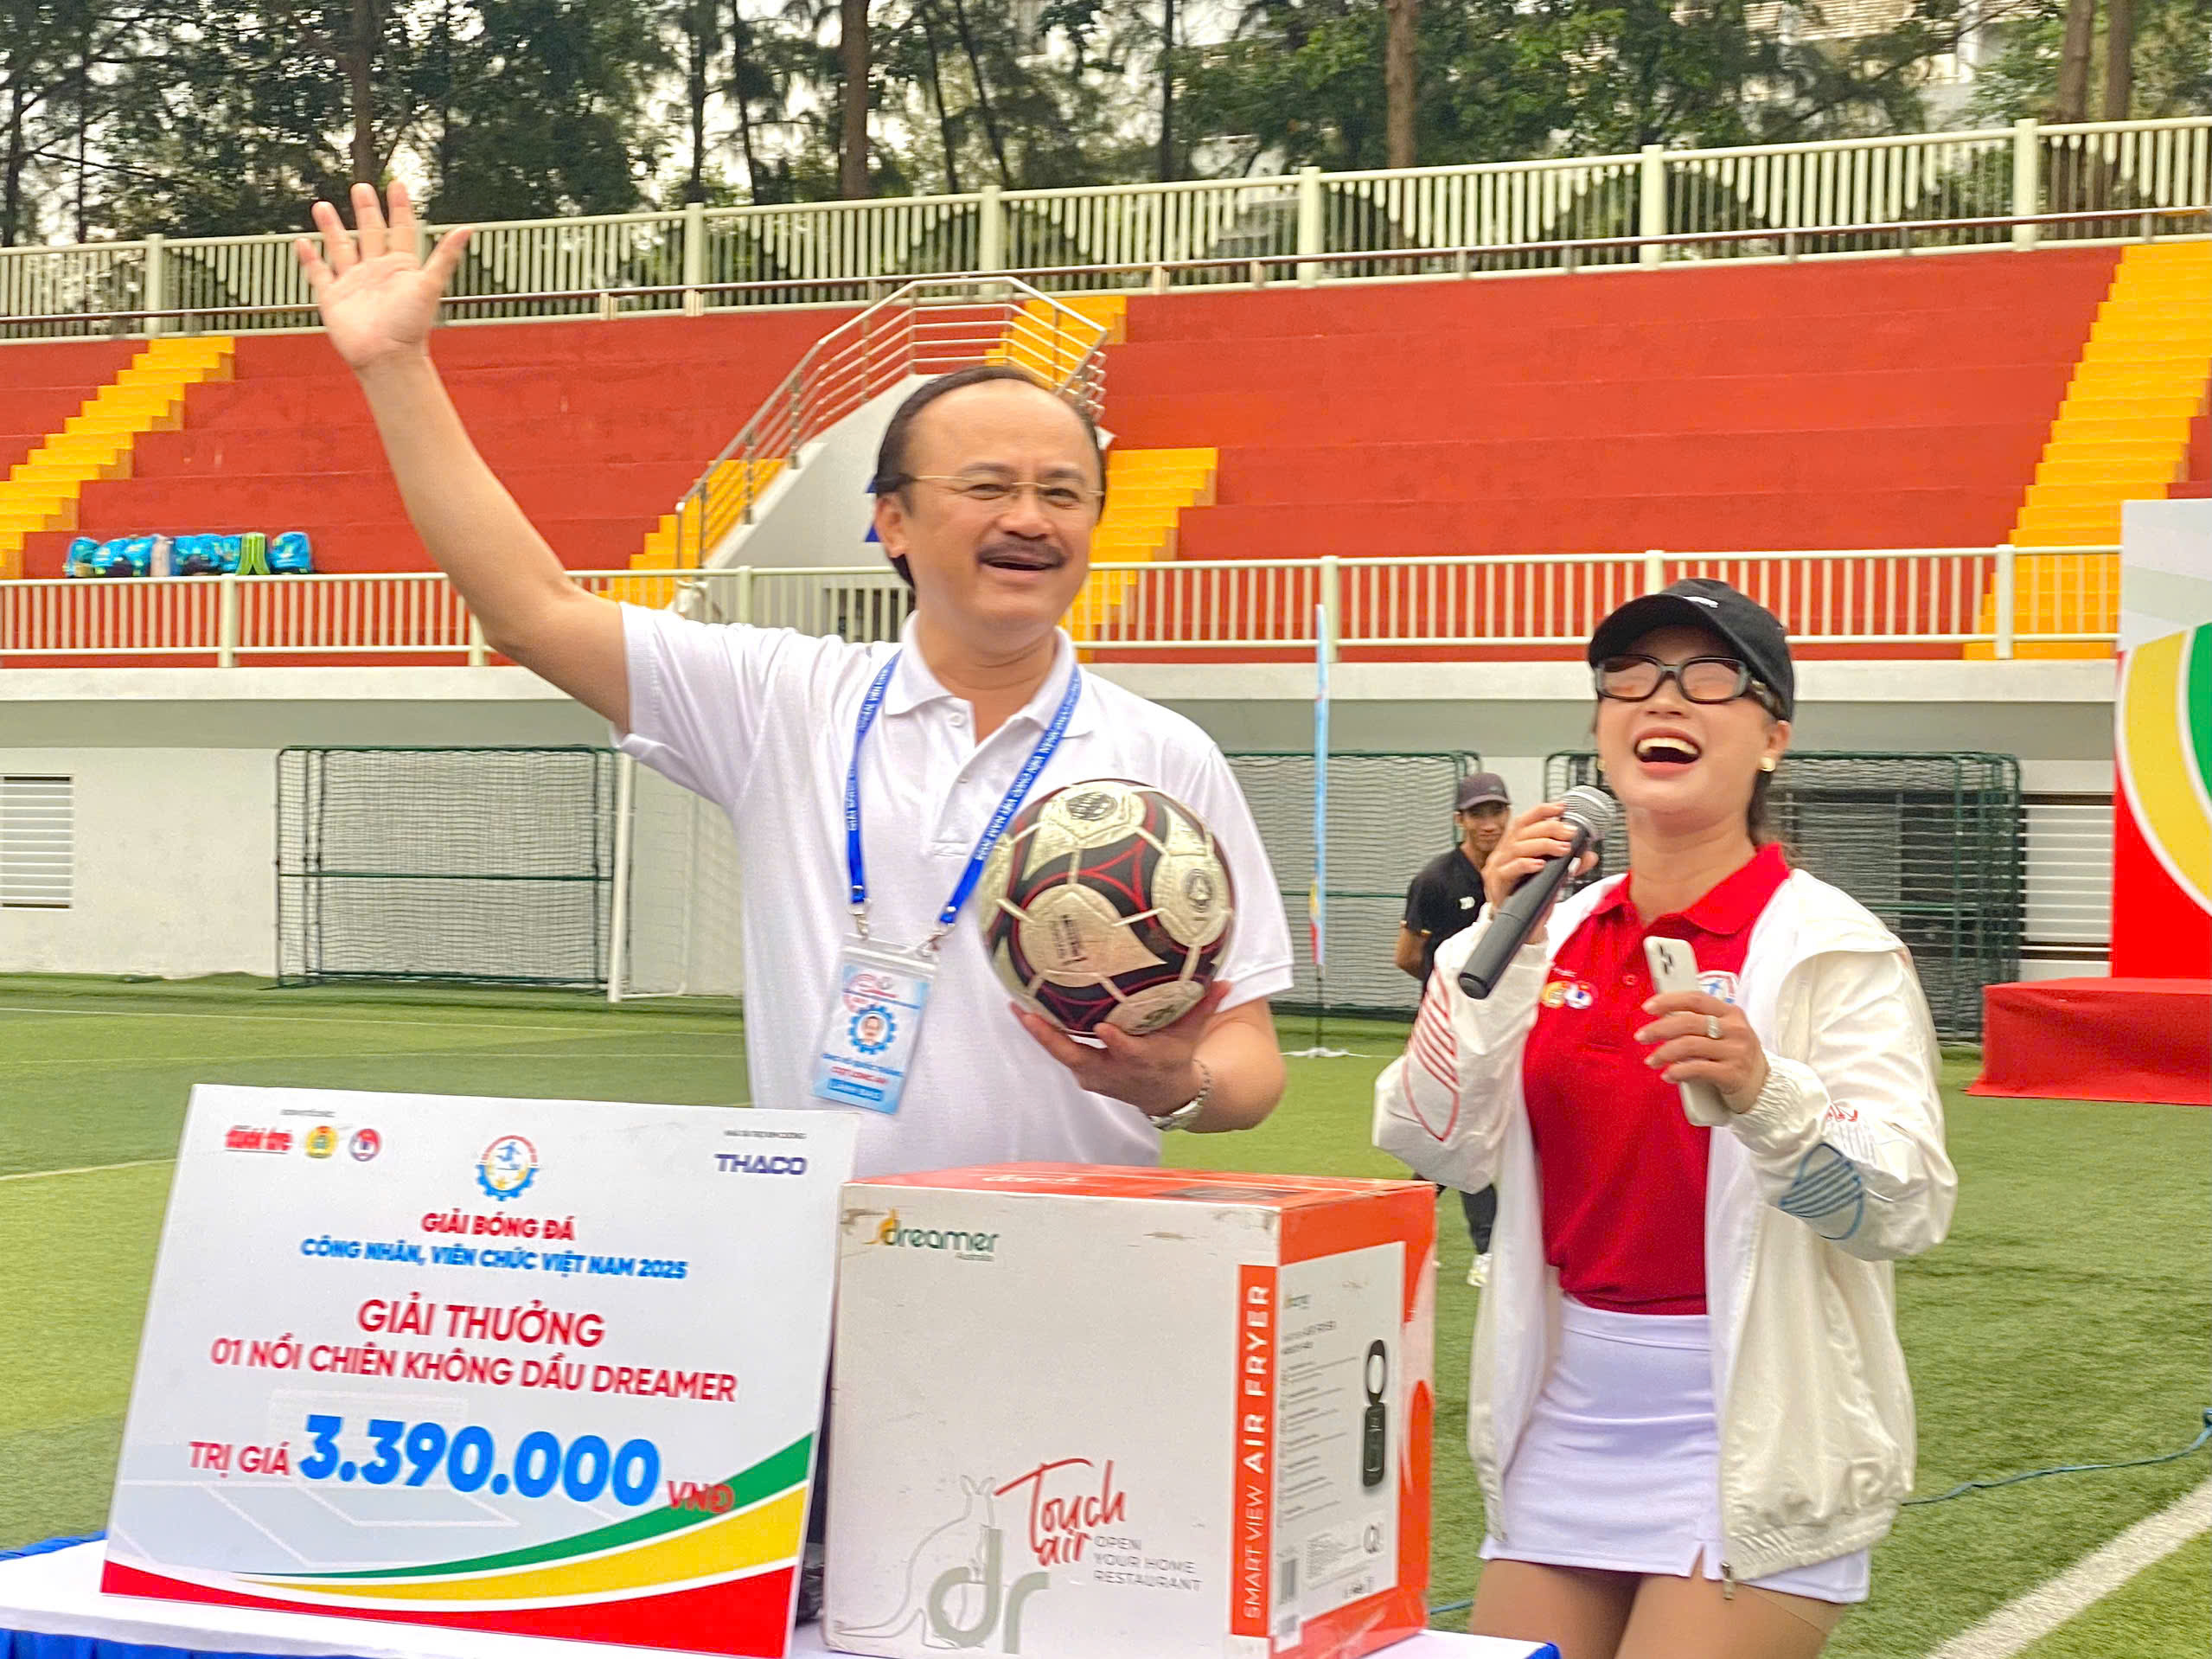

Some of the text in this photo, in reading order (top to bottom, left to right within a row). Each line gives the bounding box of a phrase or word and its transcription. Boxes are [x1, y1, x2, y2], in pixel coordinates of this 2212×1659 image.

[714, 1153, 809, 1175] THACO
[420, 1207, 576, 1240] GIẢI BÓNG ĐÁ
[876, 1207, 1000, 1252] dreamer
[301, 1234, 689, 1278] CÔNG NHÂN, VIÊN CHỨC VIỆT NAM 2025
[357, 1291, 605, 1347] GIẢI THƯỞNG
[211, 1337, 243, 1366] 01
[309, 1342, 398, 1378] CHIÊN
[402, 1347, 514, 1386] KHÔNG
[591, 1364, 738, 1403] DREAMER
[189, 1440, 233, 1479] TRỊ
[238, 1440, 292, 1476] GIÁ
[297, 1413, 662, 1507] 3.390.000
[1243, 1285, 1270, 1619] SMART VIEW AIR FRYER
[994, 1457, 1127, 1554] Touch
[1038, 1528, 1091, 1567] air
[1093, 1535, 1142, 1551] OPEN
[1093, 1553, 1197, 1574] YOUR HOME
[1093, 1569, 1203, 1592] RESTAURANT
